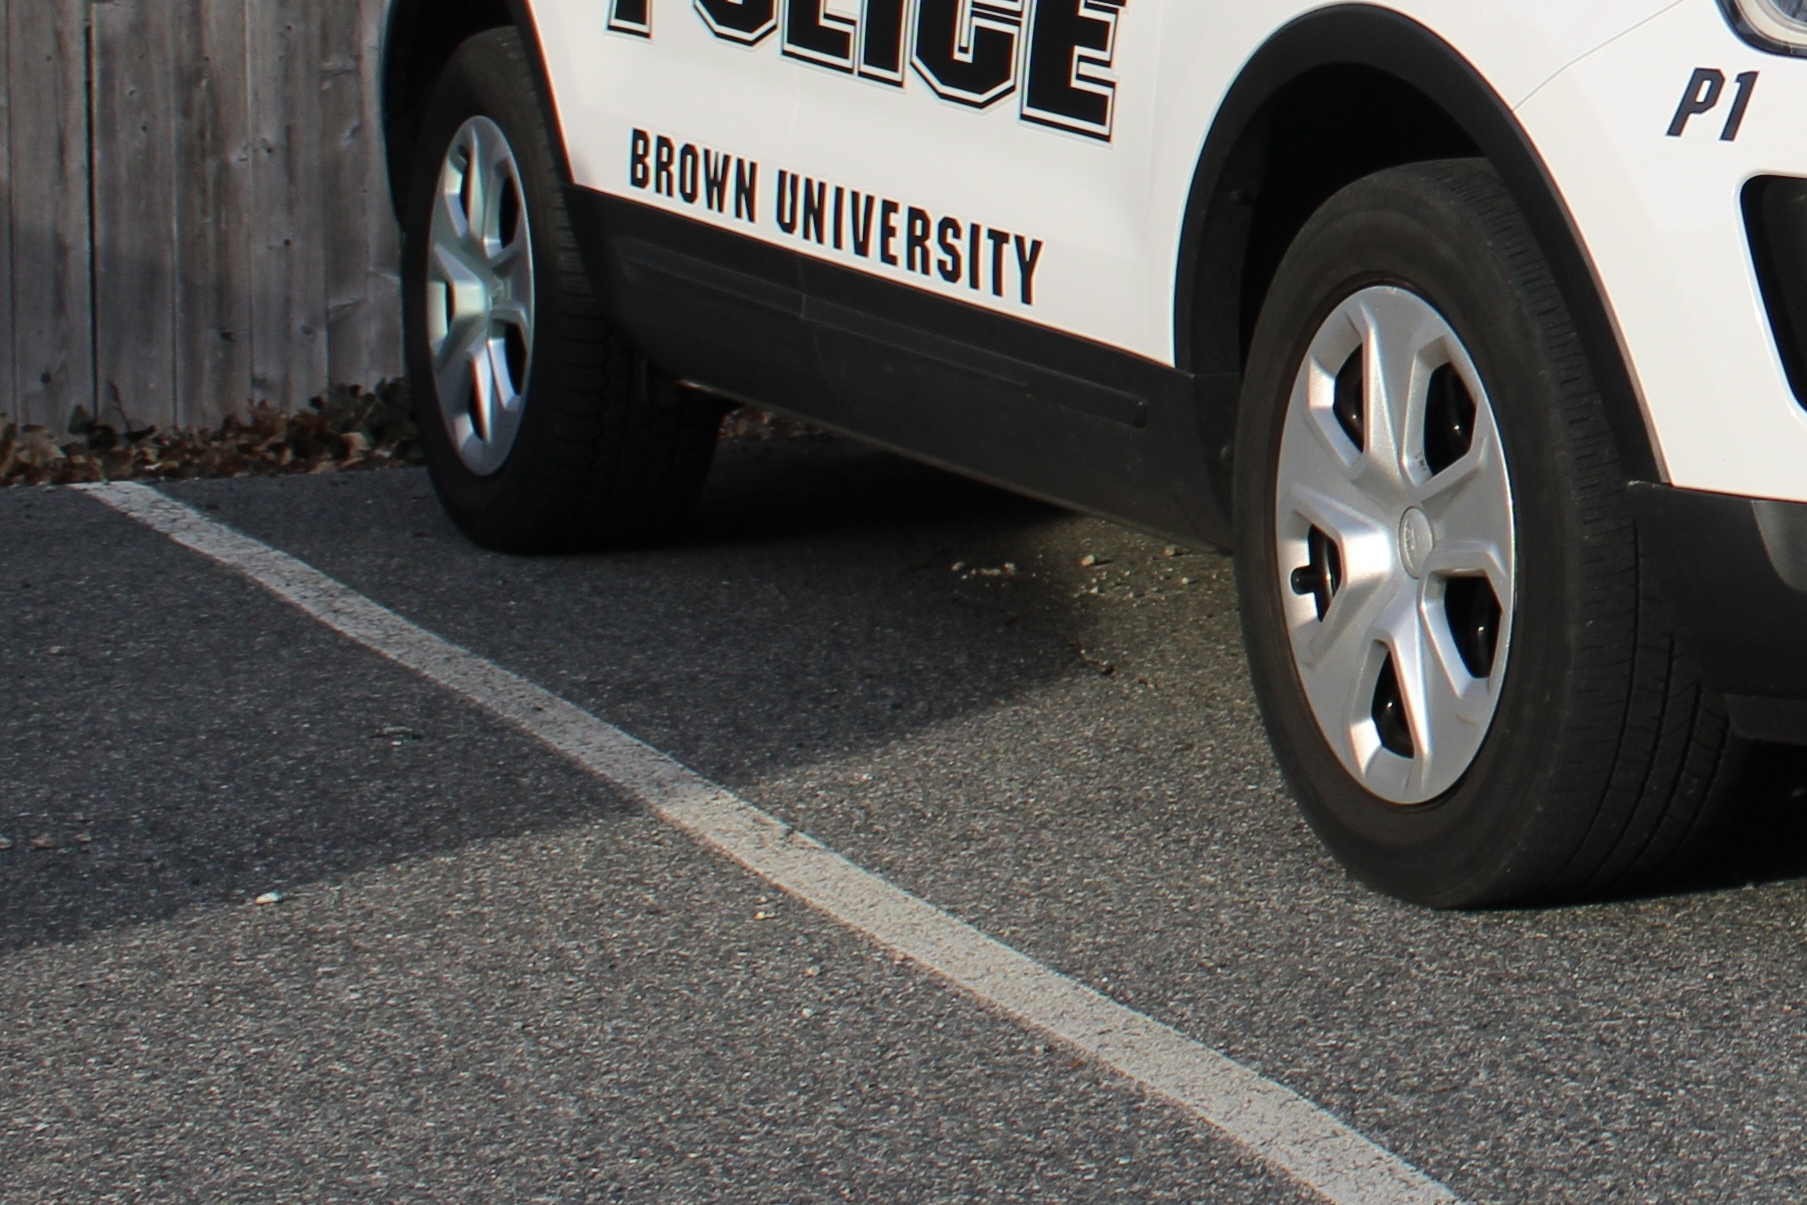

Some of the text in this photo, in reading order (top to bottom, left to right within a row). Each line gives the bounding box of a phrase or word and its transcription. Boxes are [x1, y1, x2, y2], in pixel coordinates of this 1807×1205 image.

[1665, 67, 1760, 142] P1
[629, 127, 1044, 307] BROWN UNIVERSITY
